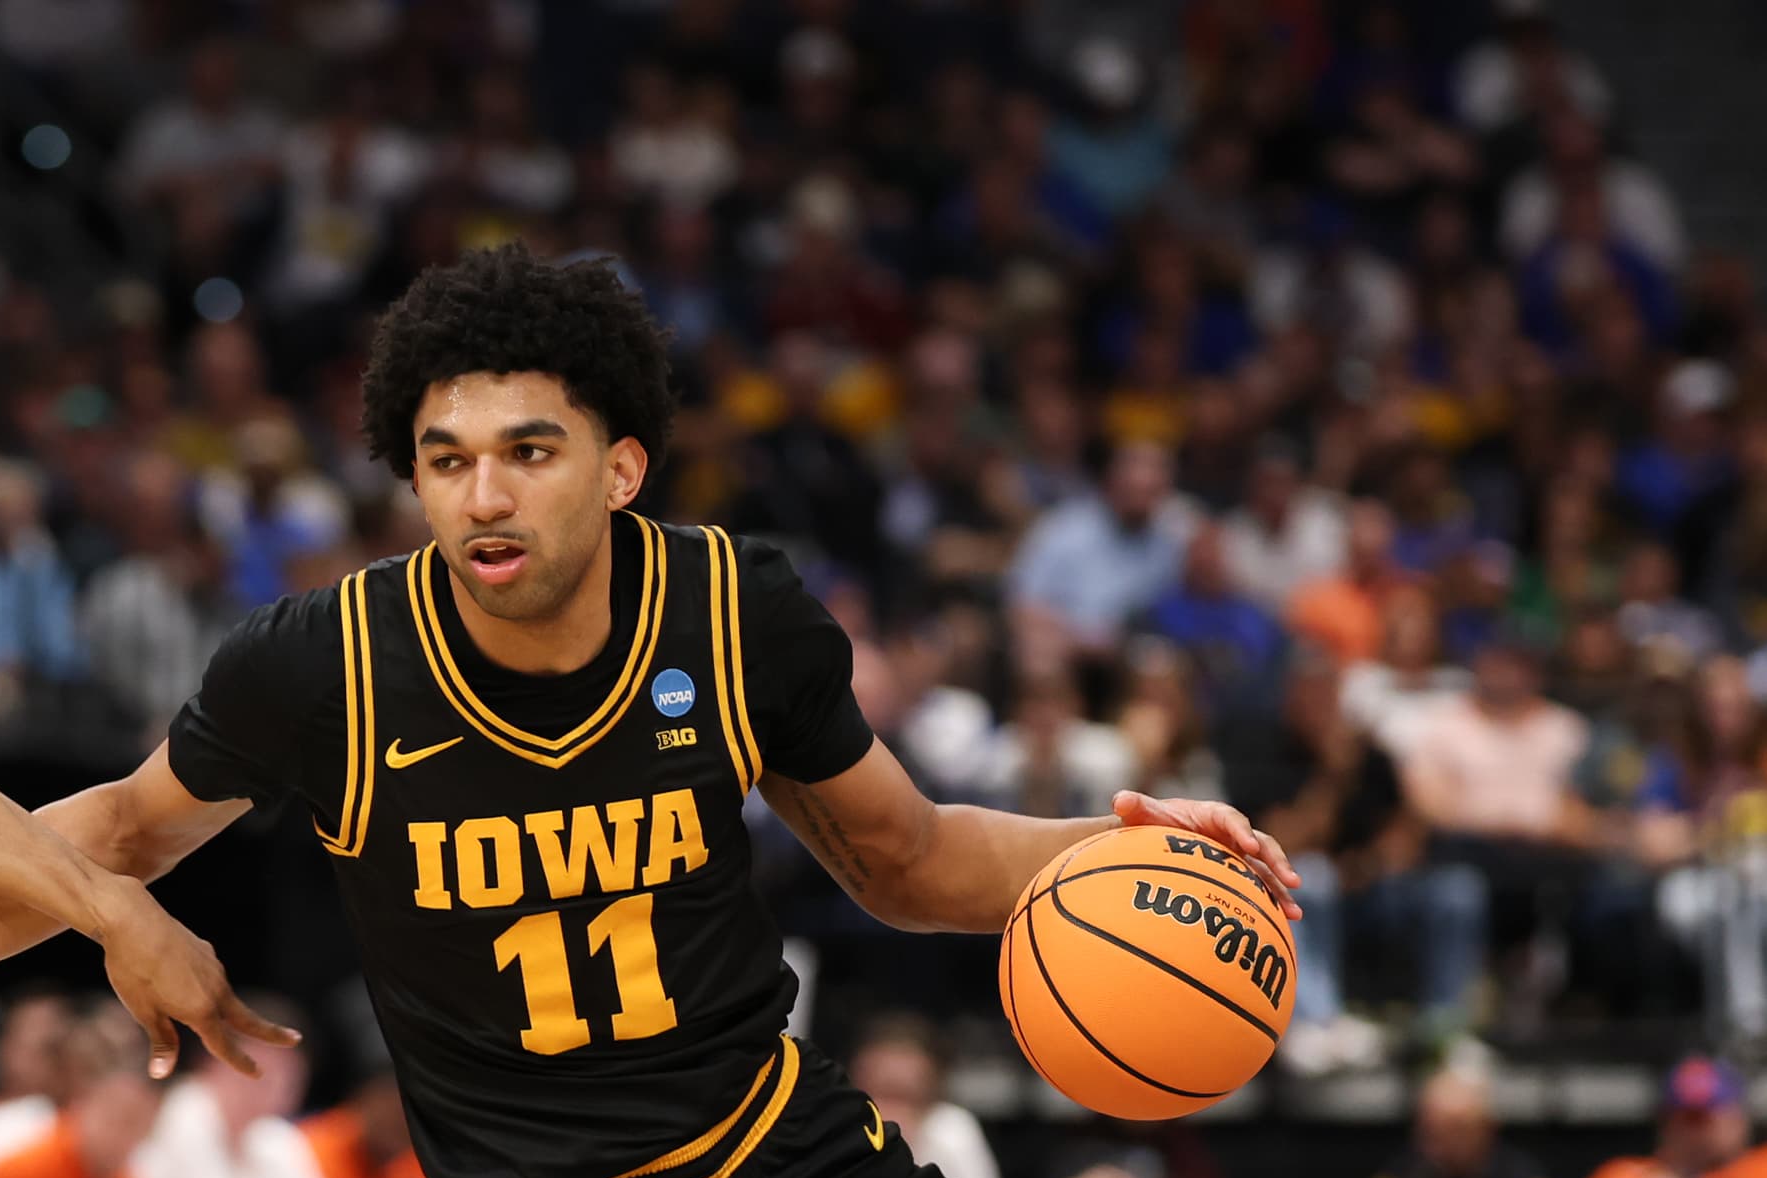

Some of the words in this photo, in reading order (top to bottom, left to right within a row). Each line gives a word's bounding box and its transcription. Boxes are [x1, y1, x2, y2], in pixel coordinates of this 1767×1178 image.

[658, 690, 693, 706] NCAA
[408, 788, 709, 910] IOWA
[1206, 892, 1231, 909] NXT
[1234, 907, 1256, 924] EVO
[493, 892, 678, 1055] 11
[1133, 880, 1288, 1011] Wilson
